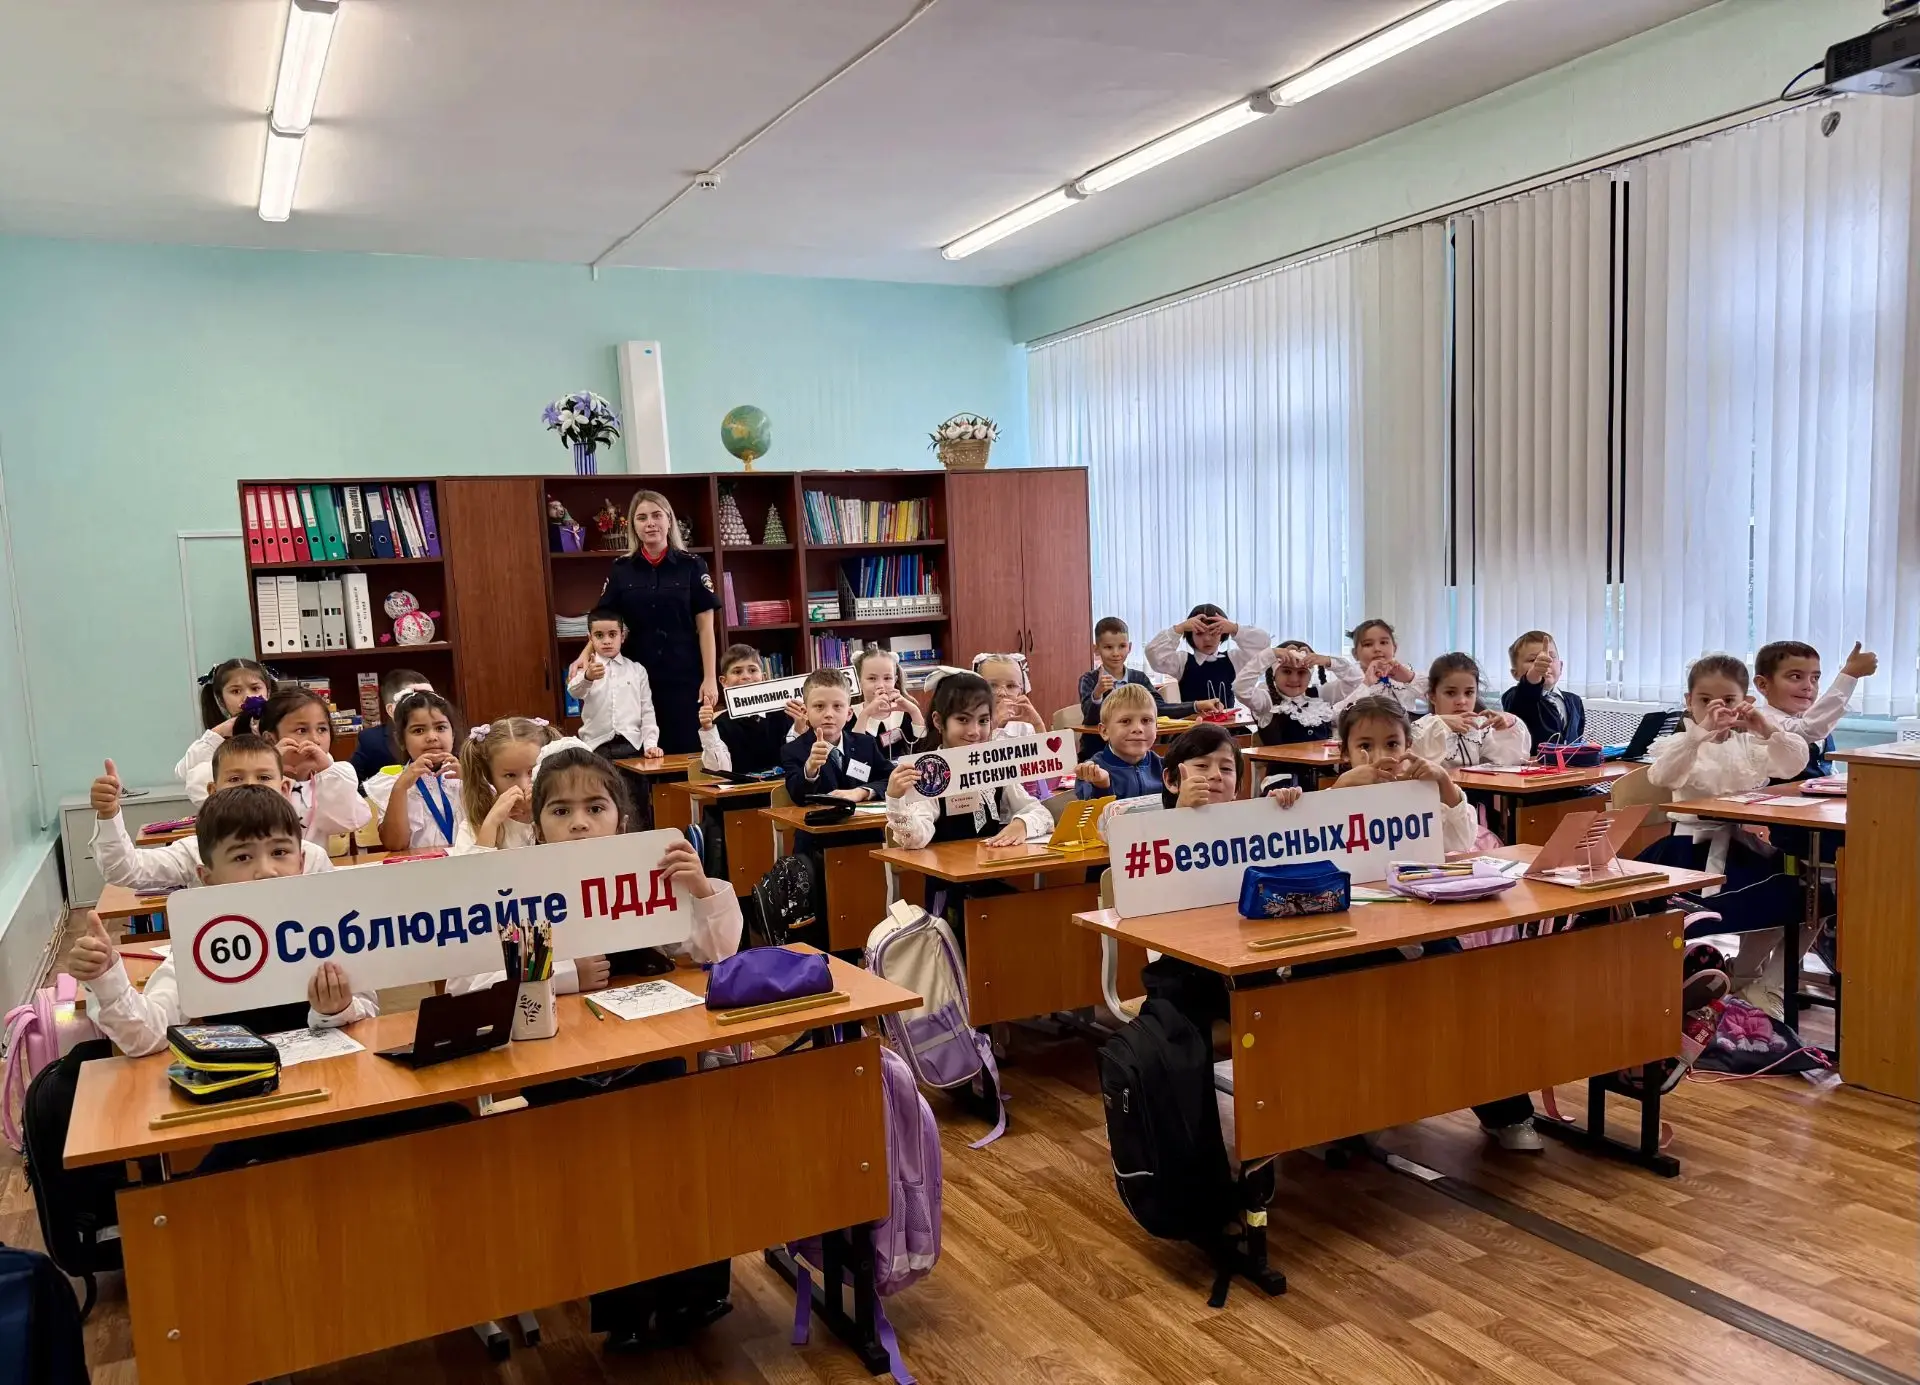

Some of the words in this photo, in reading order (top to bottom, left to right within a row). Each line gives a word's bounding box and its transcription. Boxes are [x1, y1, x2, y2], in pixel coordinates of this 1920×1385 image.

[960, 765, 1017, 789] ДЕТСКУЮ
[1020, 758, 1063, 776] ЖИЗНЬ
[1125, 812, 1433, 878] #БезопасныхДорог
[275, 888, 567, 963] Соблюдайте
[580, 868, 677, 920] ПДД
[210, 934, 251, 963] 60
